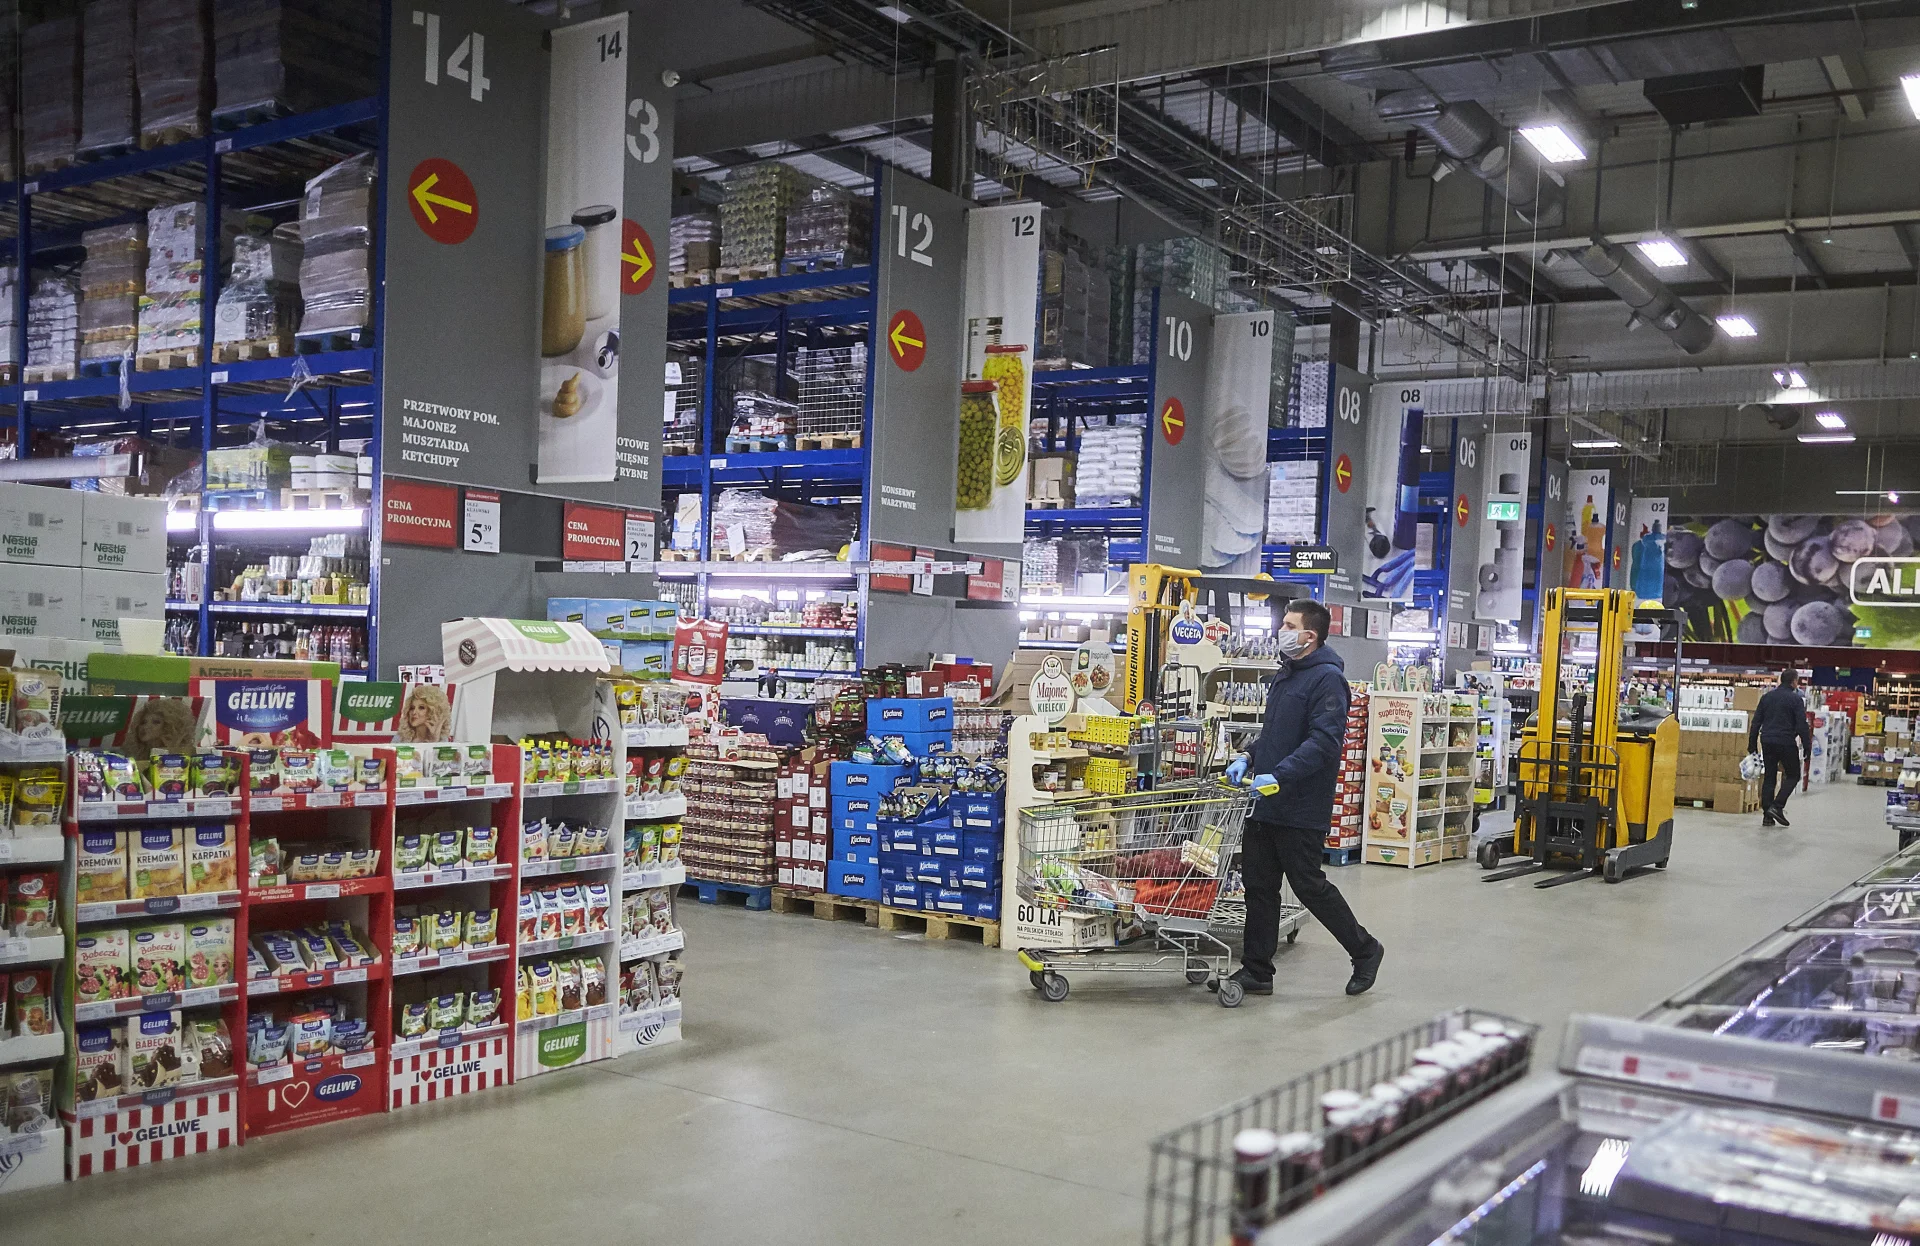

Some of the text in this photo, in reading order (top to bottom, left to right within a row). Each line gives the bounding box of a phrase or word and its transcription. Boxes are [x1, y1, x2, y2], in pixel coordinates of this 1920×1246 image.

[597, 31, 622, 63] 14
[411, 10, 491, 102] 14
[625, 98, 660, 163] 3
[1012, 215, 1035, 237] 12
[891, 204, 934, 267] 12
[1250, 320, 1269, 337] 10
[1165, 316, 1193, 361] 10
[1400, 388, 1421, 403] 08
[1338, 386, 1361, 424] 08
[403, 399, 500, 425] PRZETWORY POM.
[403, 415, 457, 434] MAJONEZ
[402, 432, 470, 453] MUSZTARDA
[616, 436, 650, 451] OTOWE
[1510, 438, 1528, 451] 06
[402, 449, 460, 467] KETCHUPY
[1459, 436, 1476, 468] 06
[615, 451, 649, 467] MIĘSNE
[619, 467, 649, 480] RYBNE
[1590, 475, 1606, 486] 04
[1548, 474, 1561, 501] 04
[387, 499, 413, 511] CENA
[881, 497, 917, 510] WARZYWNE
[1651, 502, 1666, 512] 02
[1615, 502, 1626, 527] 02
[387, 513, 453, 529] PROMOCYJNA
[567, 521, 588, 532] CENA
[471, 523, 492, 544] 5 39
[2, 534, 38, 546] Nestlé
[567, 534, 621, 547] PROMOCYJNA
[6, 547, 35, 556] płatki
[93, 542, 127, 554] Nestlé
[630, 540, 648, 560] 2 99
[97, 554, 124, 563] płatki
[1296, 551, 1332, 560] CZYTNIK
[1295, 560, 1313, 568] CEN
[1866, 568, 1920, 595] AL
[1, 615, 37, 626] Nestlé
[92, 619, 119, 630] Nestl
[5, 626, 35, 635] płatki
[95, 630, 120, 638] płatk
[521, 624, 559, 635] GELLWE
[1174, 626, 1202, 640] VEGETA
[1126, 628, 1139, 706] JUNGHEINRICH
[1036, 682, 1068, 702] Majonez
[228, 691, 296, 710] GELLWE
[347, 695, 395, 709] GELLWE
[1037, 702, 1066, 713] KIELECKI
[1378, 707, 1414, 720] superofertę
[60, 710, 119, 725] GELLWE
[883, 709, 903, 719] Kucharek
[1381, 726, 1409, 735] BoboVita
[847, 775, 867, 785] Kucharek
[848, 801, 869, 811] Kucharek
[968, 804, 990, 814] Kucharek
[143, 834, 170, 844] GELLWE
[198, 831, 223, 840] GELLWE
[894, 829, 914, 838] Kucharek
[936, 833, 956, 843] Kucharek
[86, 837, 113, 847] GELLWE
[850, 835, 871, 845] Kucharek
[78, 856, 121, 867] KREMÓWKI
[137, 853, 178, 864] KREMÓWKI
[192, 850, 231, 861] KARPATKI
[919, 861, 940, 871] Kucharek
[963, 865, 985, 875] Kucharek
[843, 875, 865, 885] Kucharek
[895, 884, 915, 893] Kucharek
[1017, 904, 1035, 923] 60
[1023, 926, 1044, 935] POLSKICH
[1081, 924, 1097, 939] 60 LAT
[140, 943, 176, 954] Babeczki
[194, 938, 227, 948] Babeczki
[81, 949, 120, 961] Babeczki
[142, 1019, 169, 1029] GELLWE
[82, 1036, 108, 1047] GELLWE
[135, 1036, 176, 1049] BABECZKI
[543, 1034, 580, 1053] GELLWE
[433, 1061, 481, 1079] GELLWE
[268, 1077, 358, 1112] I GELLWE
[136, 1119, 201, 1141] GELLWE
